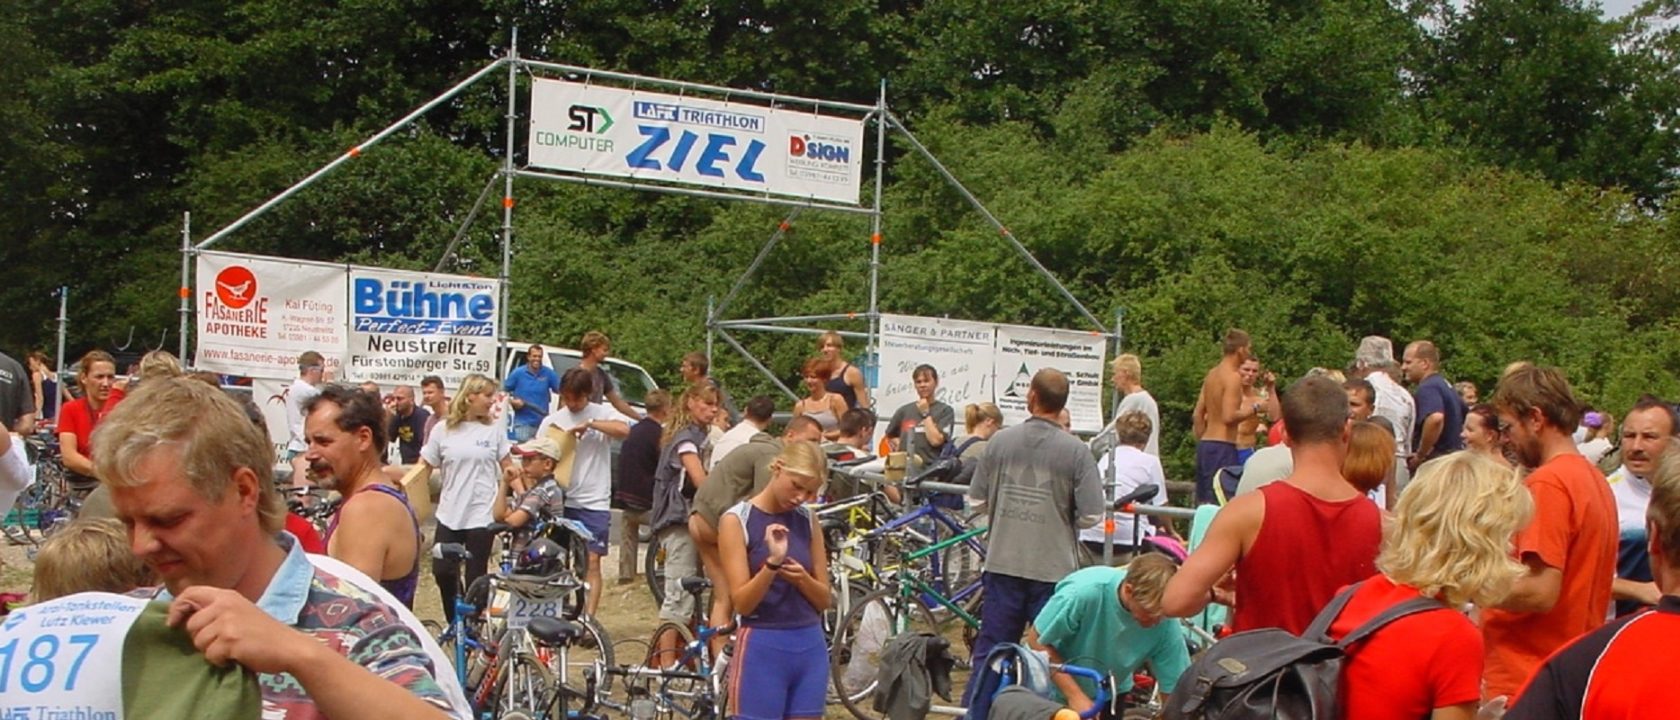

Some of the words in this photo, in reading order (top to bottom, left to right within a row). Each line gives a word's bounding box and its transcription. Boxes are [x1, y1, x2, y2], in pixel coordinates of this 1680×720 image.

[682, 109, 759, 130] TRIATHLON
[535, 131, 614, 153] COMPUTER
[625, 124, 767, 183] ZIEL
[354, 277, 495, 321] Bühne
[205, 322, 268, 339] APOTHEKE
[356, 316, 494, 335] Perfect-Event
[940, 328, 990, 341] PARTNER
[367, 335, 478, 356] Neustrelitz
[351, 355, 449, 372] Fürstenberger
[514, 600, 558, 618] 228
[0, 634, 100, 694] 187
[35, 705, 116, 720] Triathlon
